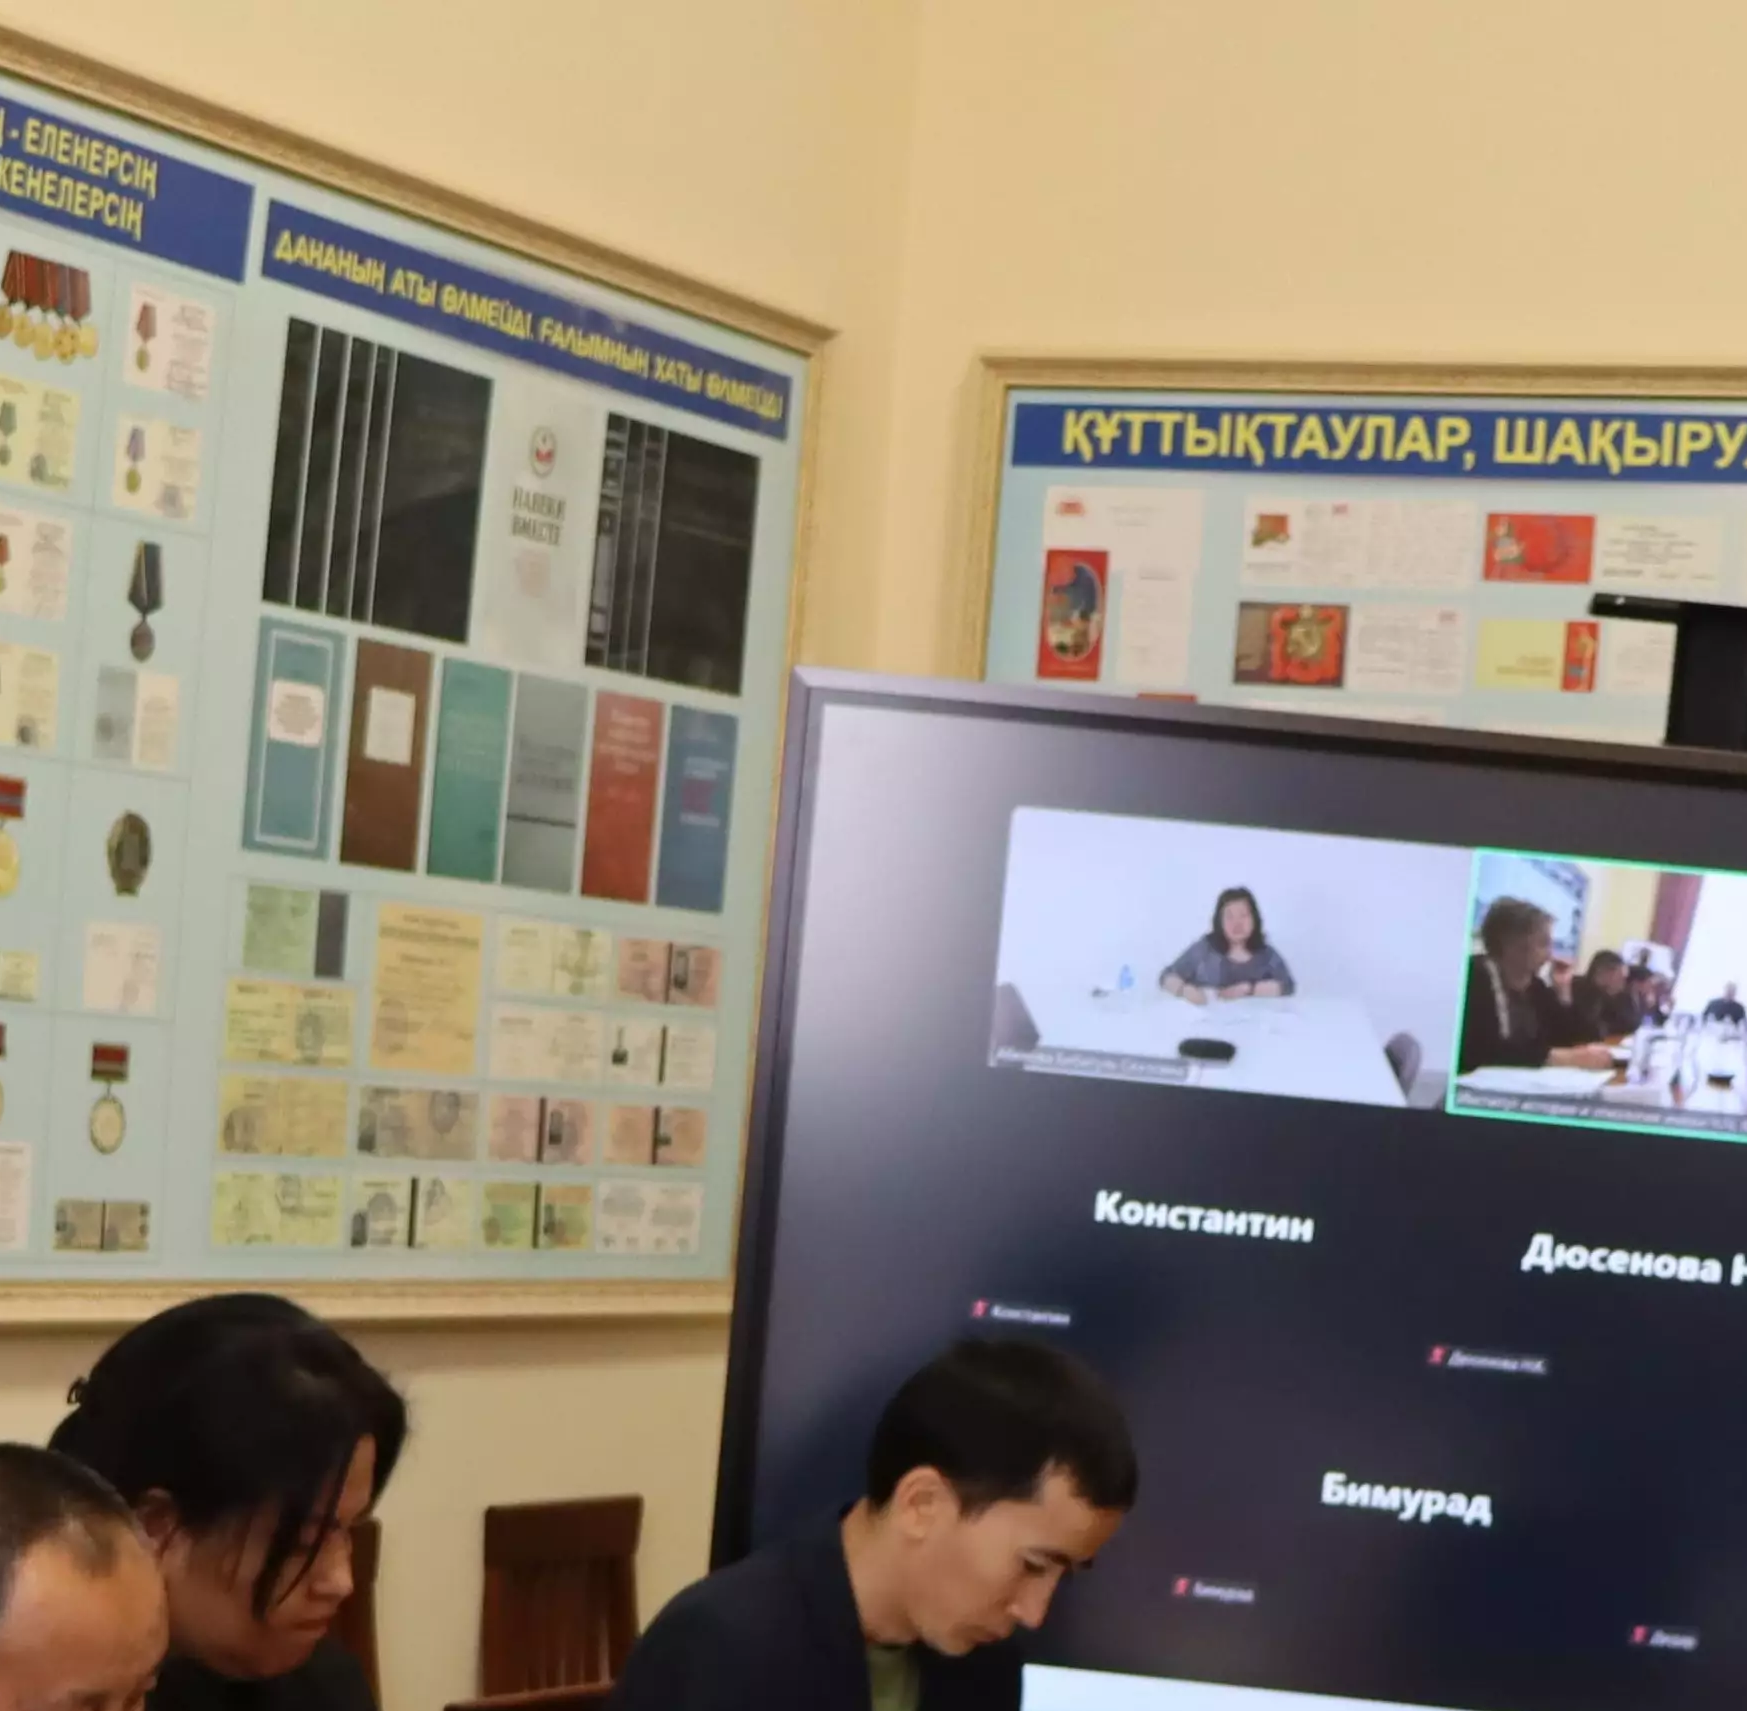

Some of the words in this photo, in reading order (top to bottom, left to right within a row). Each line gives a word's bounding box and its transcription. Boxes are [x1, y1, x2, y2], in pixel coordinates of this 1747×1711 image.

[23, 116, 158, 199] ЕЛЕНЕРСІҢ
[273, 229, 386, 295] ДАНАНЫҢ
[390, 267, 438, 307] АТЫ
[539, 316, 650, 380] ҒАЛЫМНЫҢ
[652, 353, 703, 393] ХАТЫ
[1061, 408, 1477, 471] ҚҰТТЫҚТАУЛАР,
[1094, 1189, 1315, 1243] Константин
[1521, 1232, 1722, 1286] Дюсенова
[1320, 1471, 1493, 1528] Бимурад
